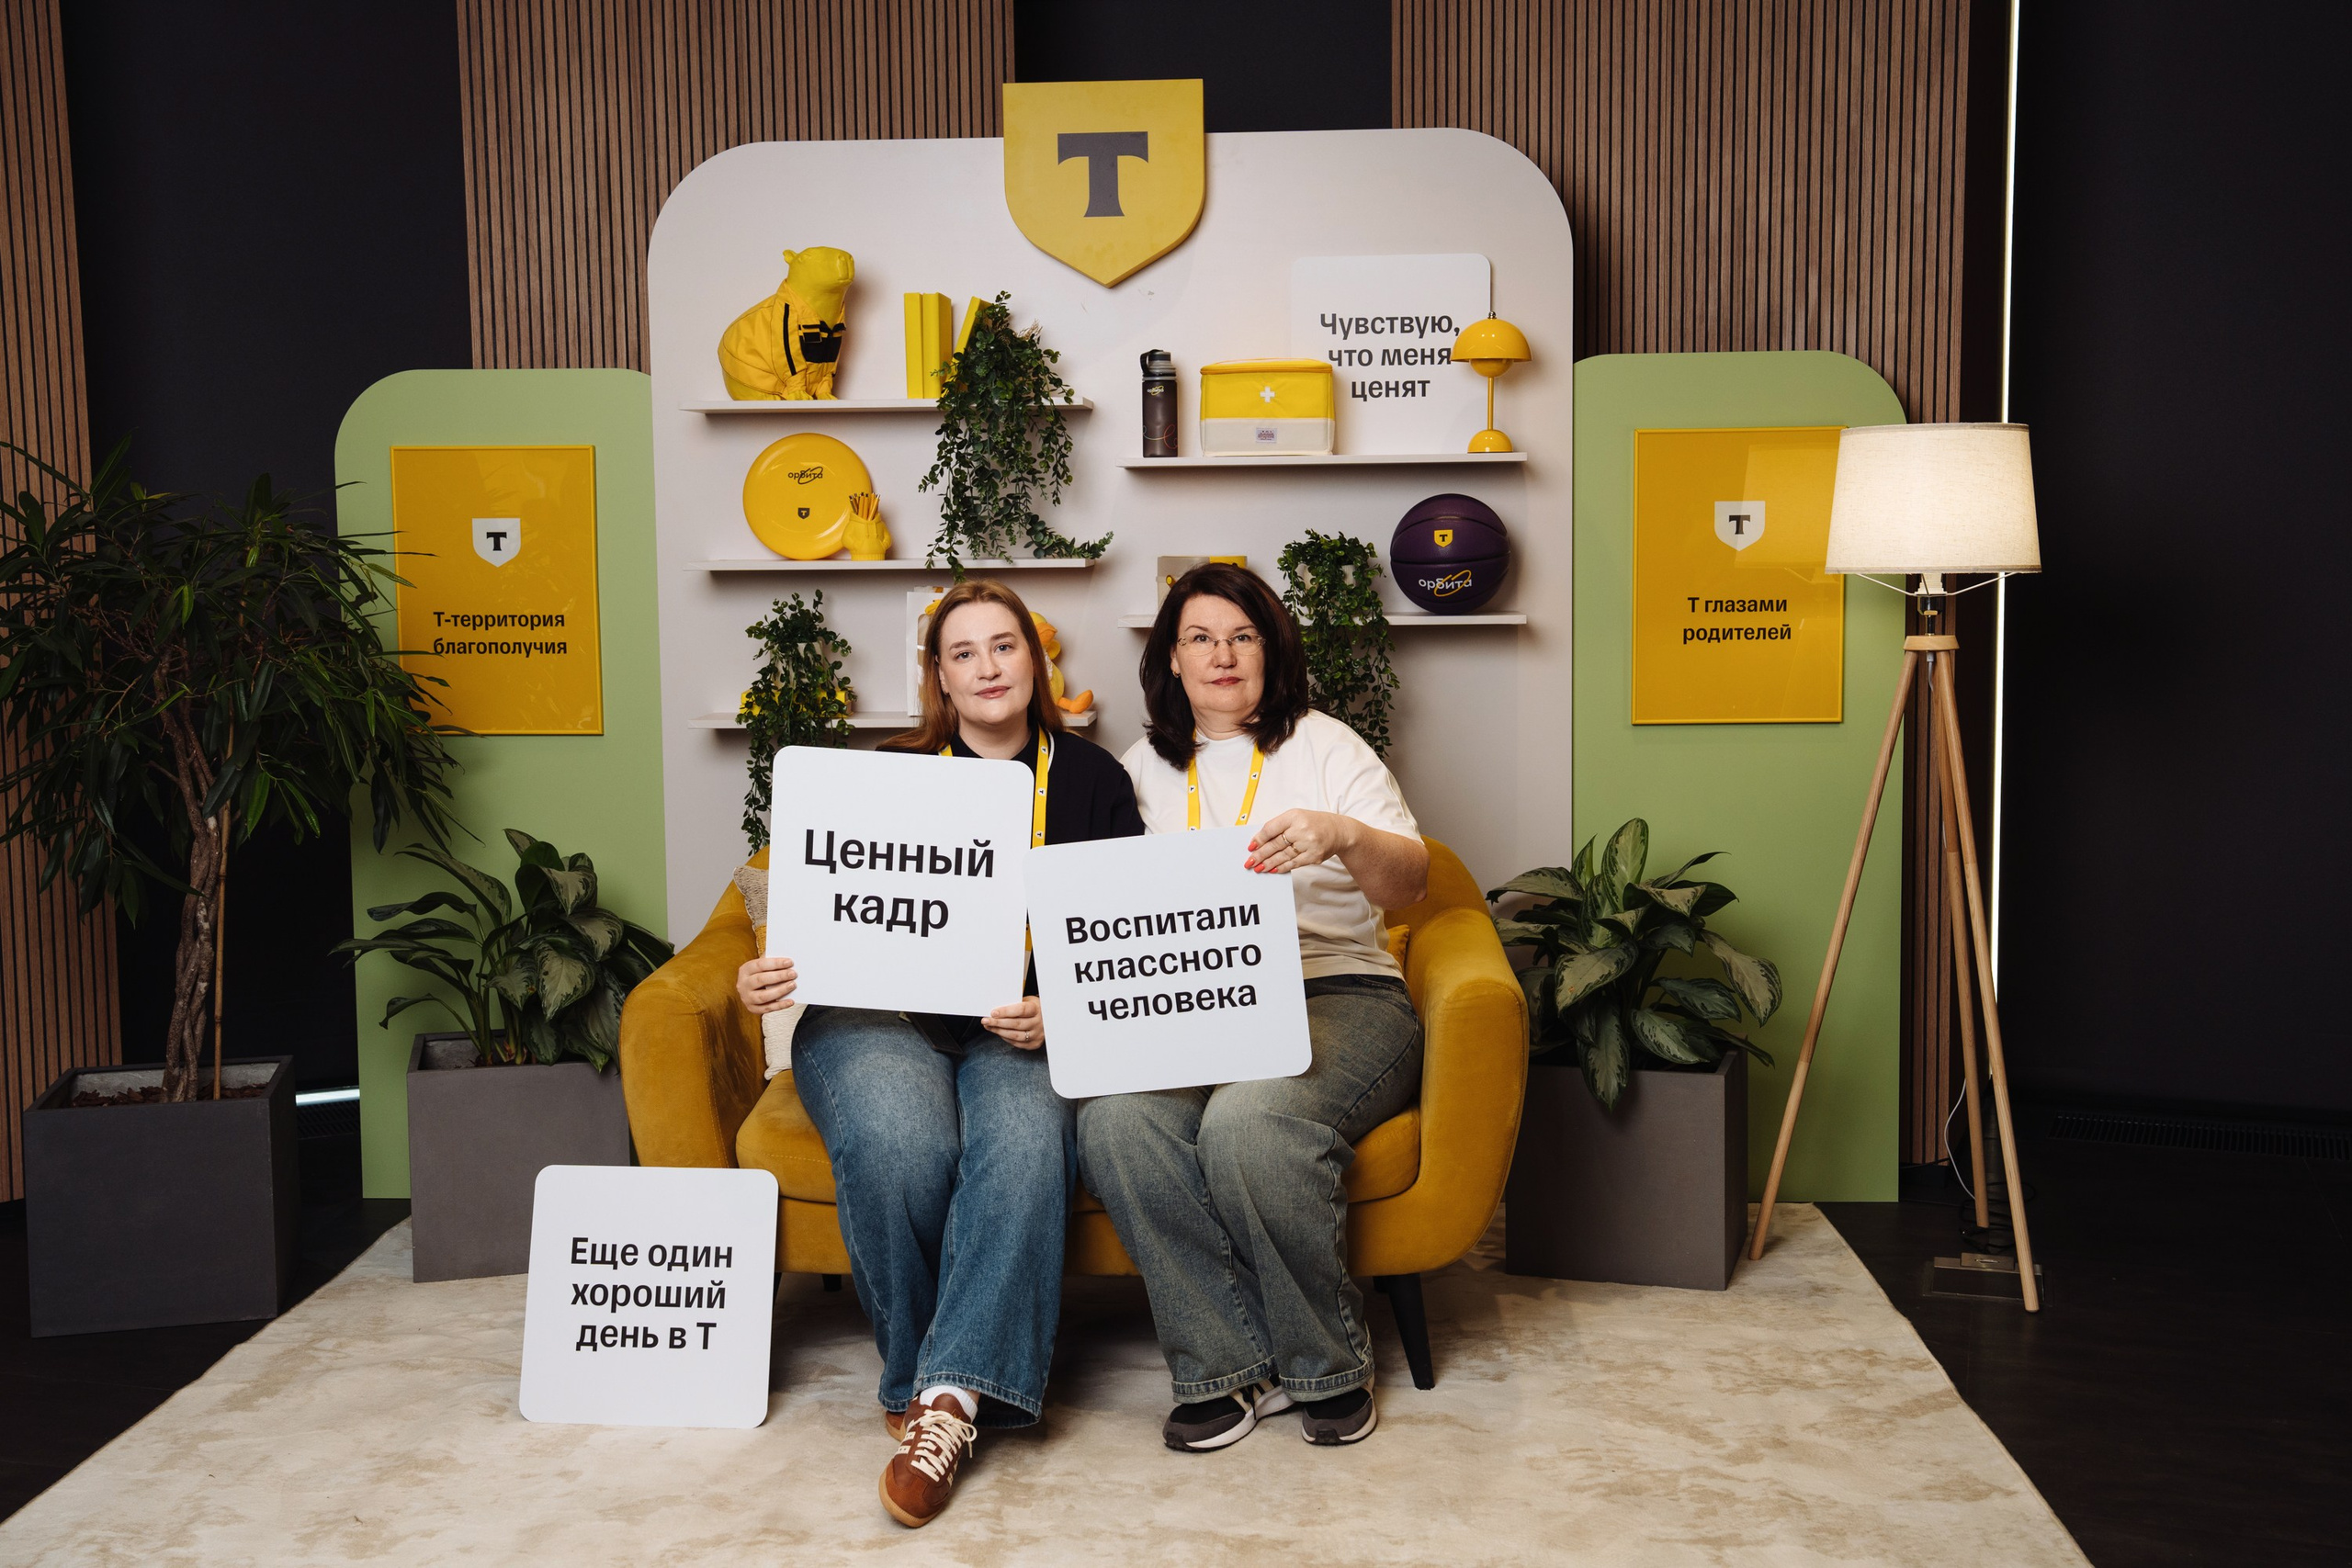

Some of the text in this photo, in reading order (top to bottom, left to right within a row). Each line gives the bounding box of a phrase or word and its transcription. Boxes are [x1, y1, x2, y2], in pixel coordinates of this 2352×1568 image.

[1057, 131, 1148, 217] Т
[1320, 313, 1460, 340] Чувствую,
[1329, 348, 1454, 367] что меня
[1351, 380, 1430, 401] ценят
[1729, 515, 1750, 535] Т
[486, 532, 507, 551] Т
[1419, 577, 1472, 591] орбита
[1687, 596, 1787, 613] Т глазами
[433, 611, 565, 631] Т-территория
[1683, 625, 1792, 644] родителей
[433, 637, 567, 658] благополучия
[805, 829, 994, 878] Ценный
[833, 893, 949, 938] кадр
[1065, 903, 1261, 944] Воспитали
[1074, 944, 1261, 984] классного
[1088, 985, 1257, 1021] человека
[571, 1236, 733, 1271] Еще один
[571, 1280, 726, 1314] хороший
[575, 1322, 718, 1352] день в Т
